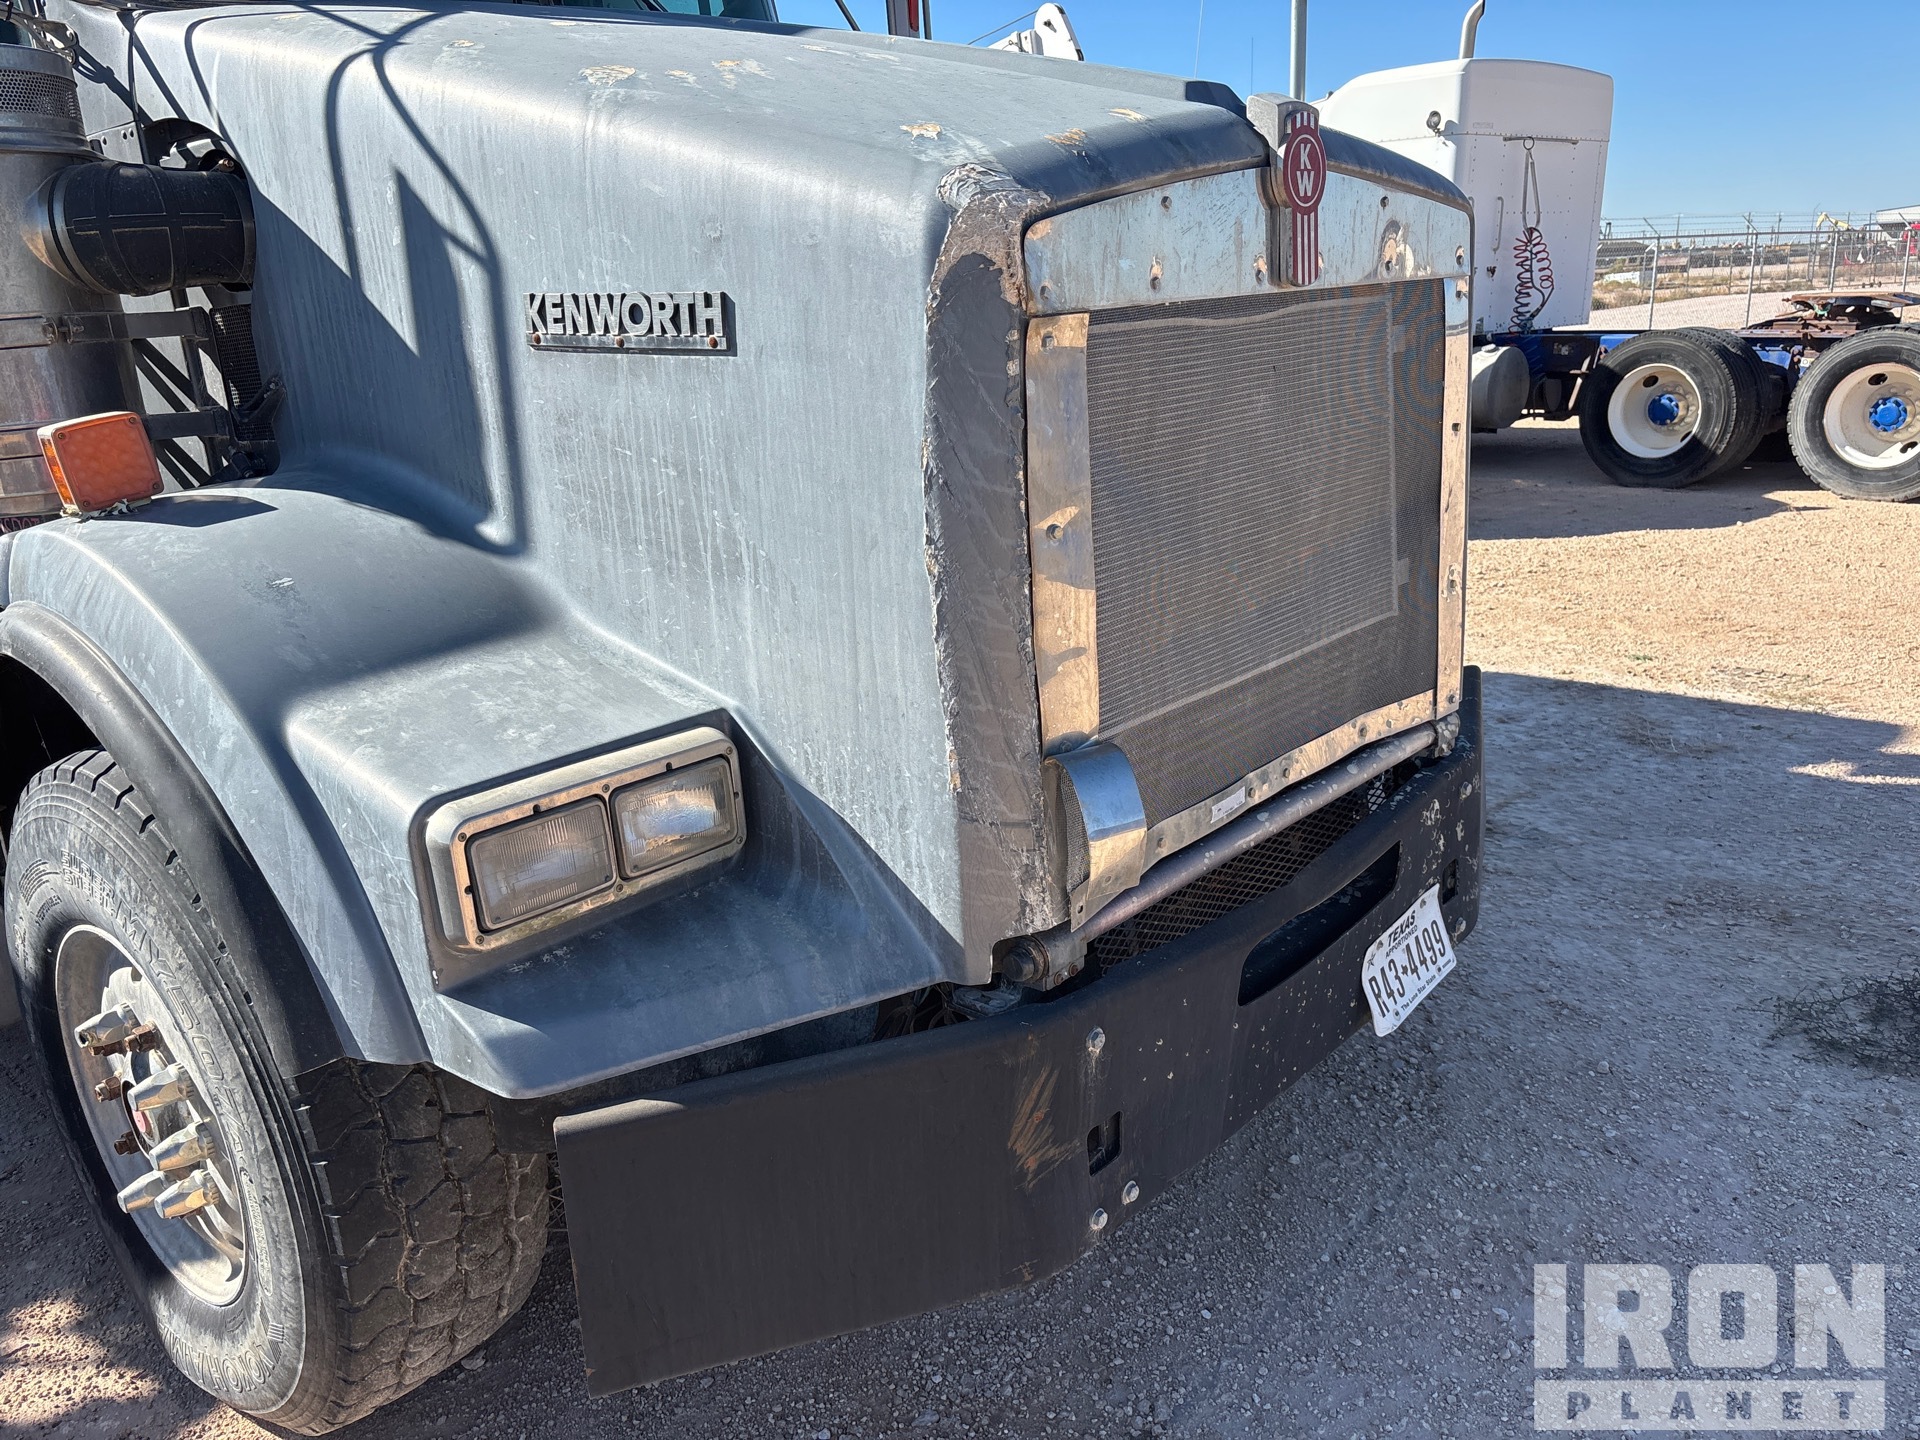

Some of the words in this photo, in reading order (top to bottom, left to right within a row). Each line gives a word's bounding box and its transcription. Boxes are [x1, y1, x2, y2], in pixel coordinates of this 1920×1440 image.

[1300, 143, 1312, 170] K
[1296, 170, 1315, 197] W
[523, 291, 725, 337] KENWORTH
[1385, 925, 1418, 958] APPORTIONED
[1387, 909, 1416, 948] TEXAS
[1401, 1001, 1410, 1011] The
[1409, 993, 1418, 1005] Lone
[1417, 983, 1427, 995] Star
